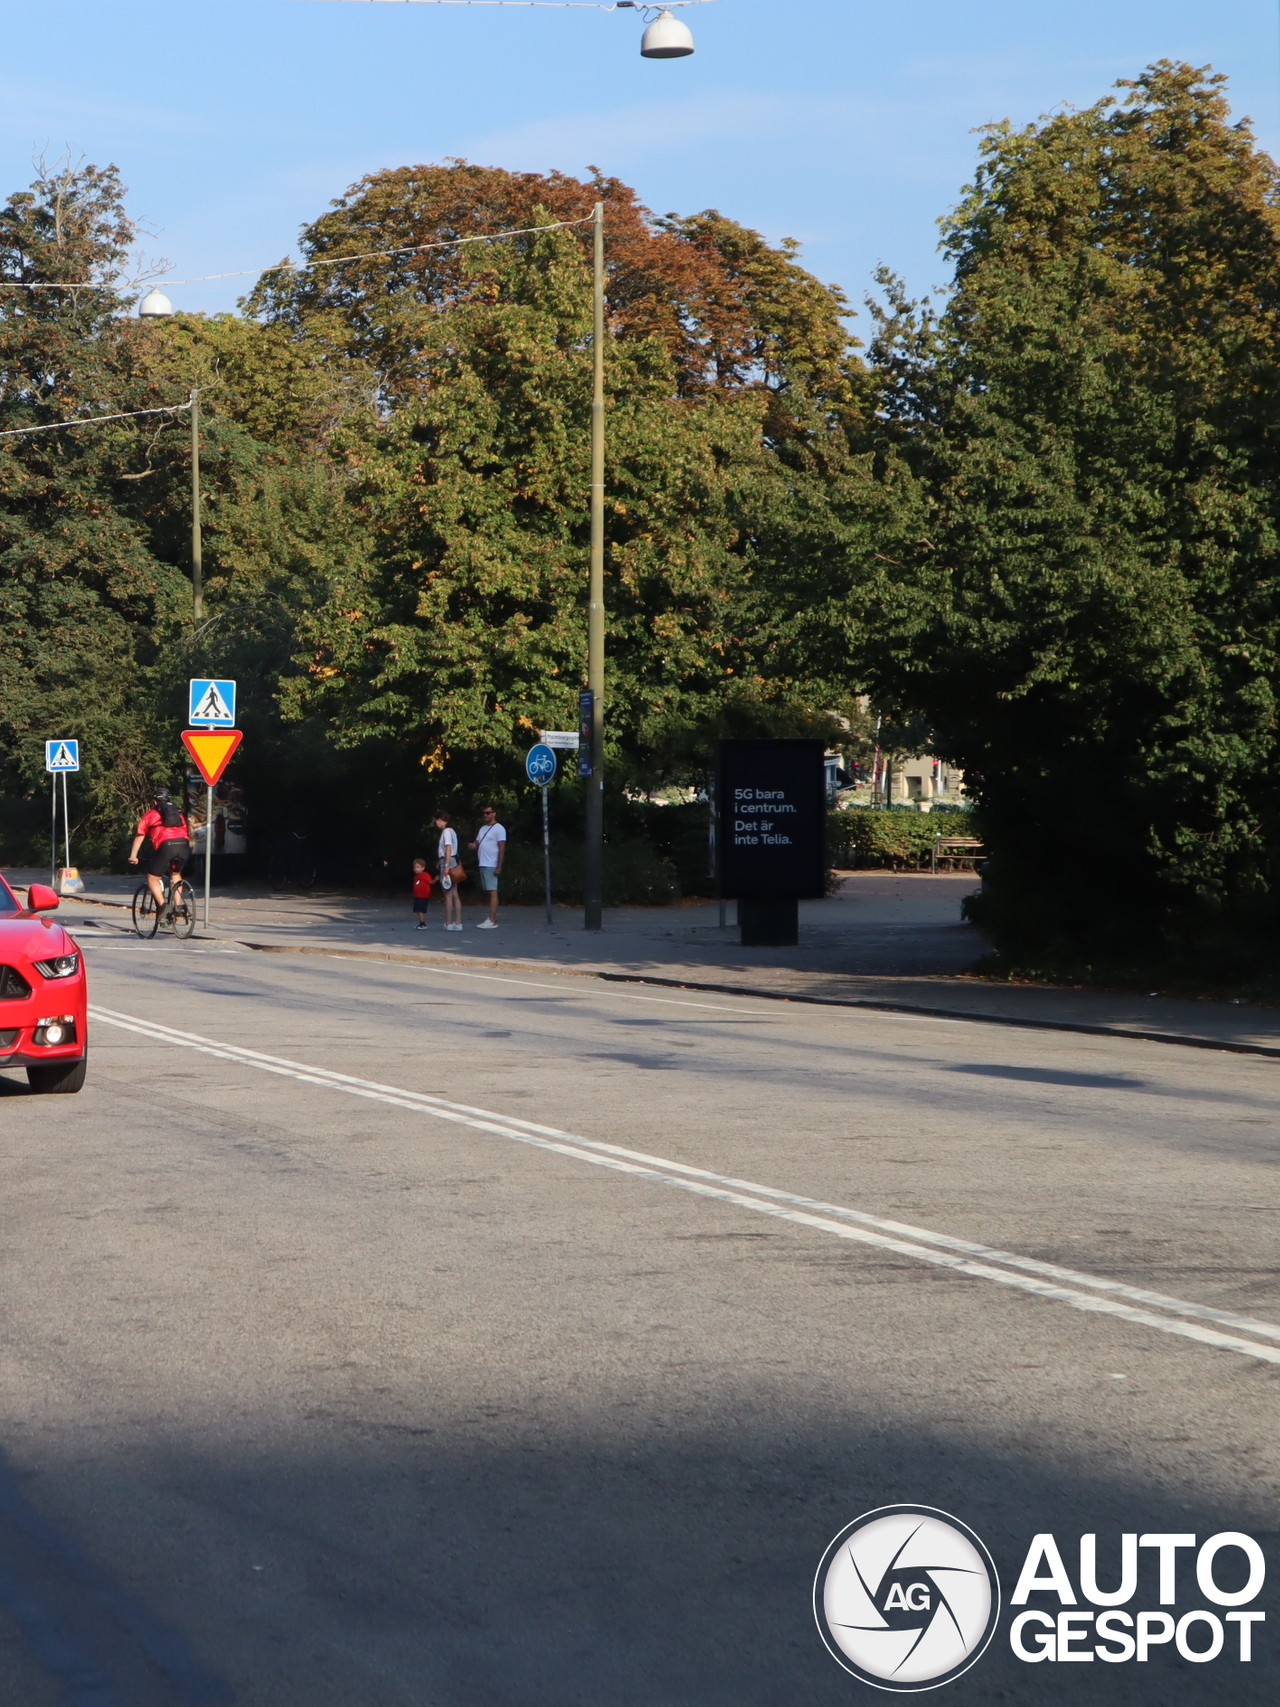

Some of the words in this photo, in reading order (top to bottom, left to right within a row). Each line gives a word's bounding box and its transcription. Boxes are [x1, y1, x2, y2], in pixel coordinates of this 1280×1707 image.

[734, 788, 753, 799] 5G
[755, 788, 785, 799] bara
[734, 803, 738, 813] i
[740, 803, 797, 813] centrum.
[734, 821, 758, 831] Det
[760, 820, 774, 831] är
[734, 834, 759, 845] inte
[761, 834, 792, 845] Telia.
